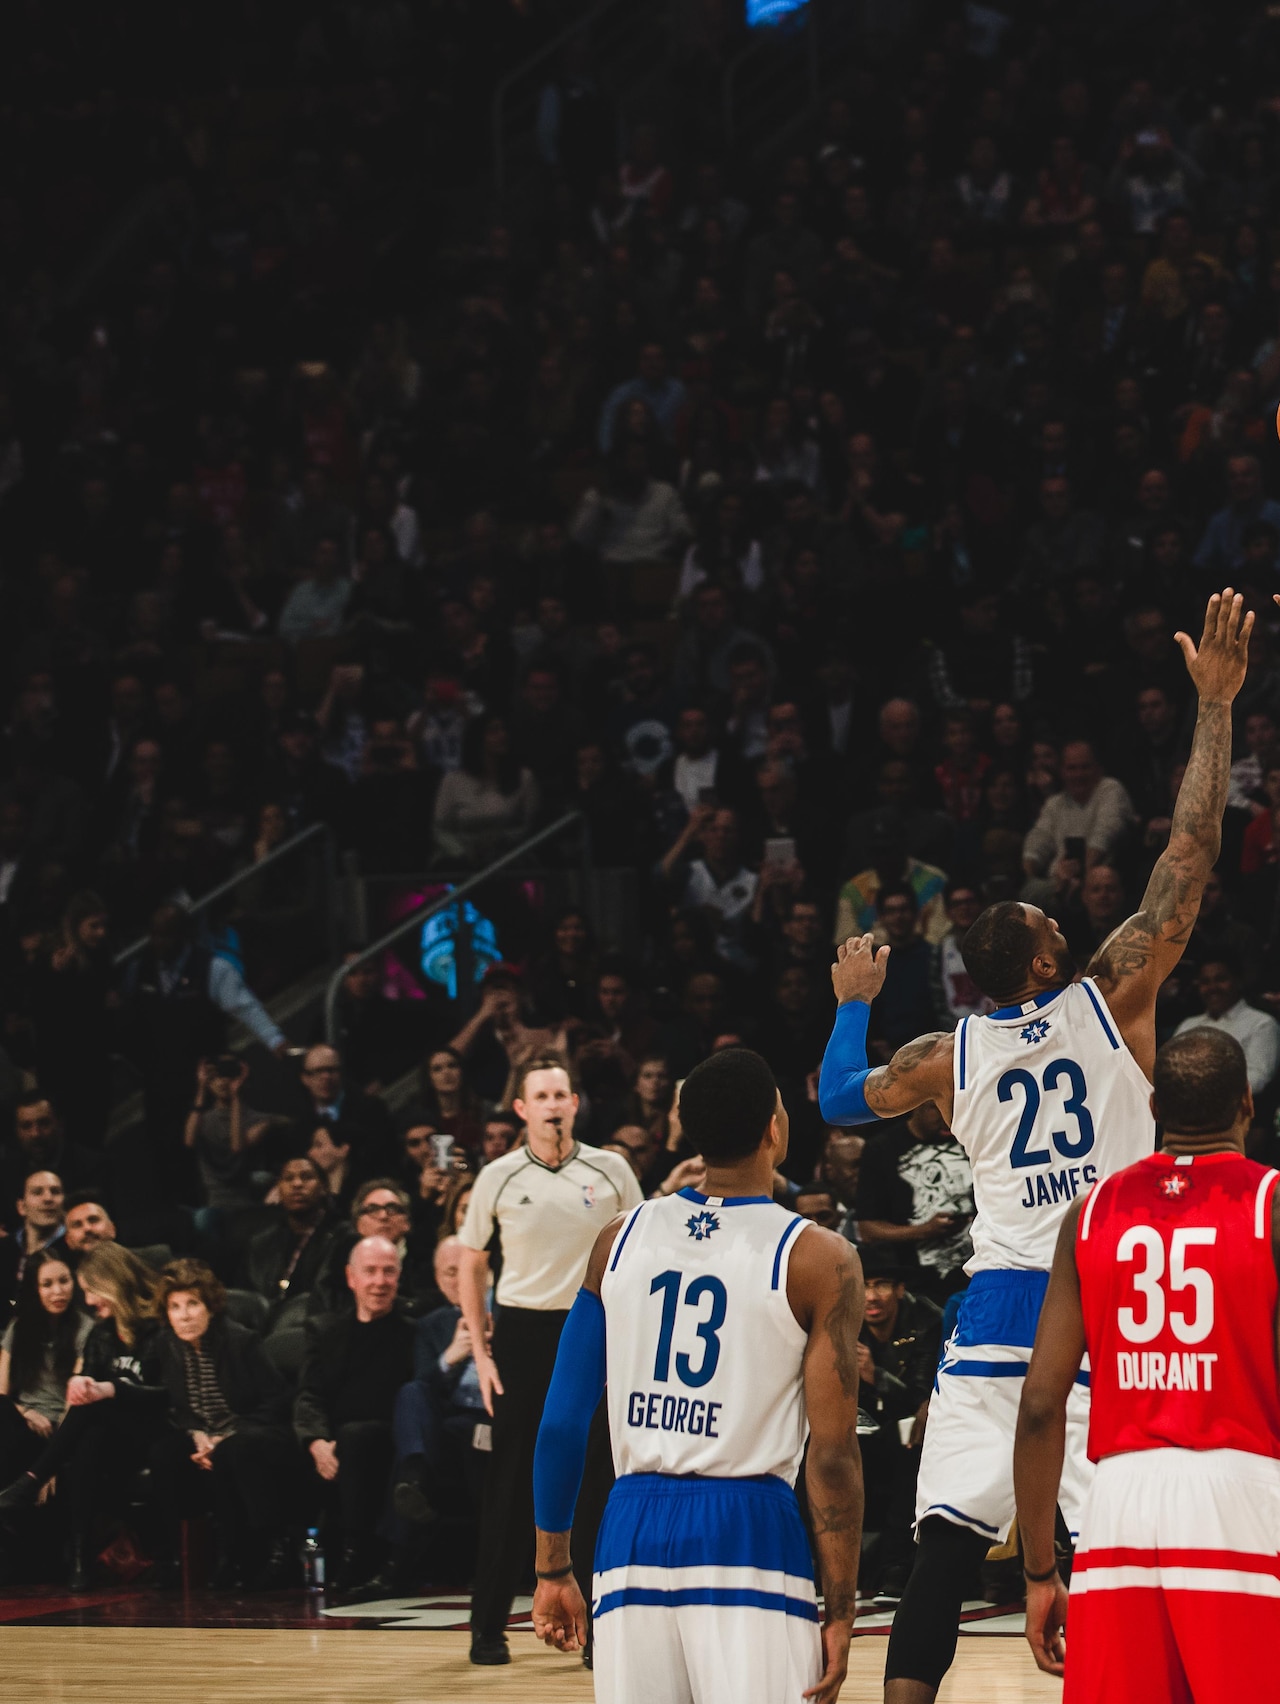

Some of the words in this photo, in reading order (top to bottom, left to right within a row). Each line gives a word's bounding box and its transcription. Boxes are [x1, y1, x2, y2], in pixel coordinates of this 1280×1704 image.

[997, 1058, 1095, 1169] 23
[1022, 1164, 1098, 1208] JAMES
[1116, 1224, 1217, 1345] 35
[649, 1269, 728, 1388] 13
[1117, 1352, 1218, 1391] DURANT
[627, 1391, 722, 1438] GEORGE
